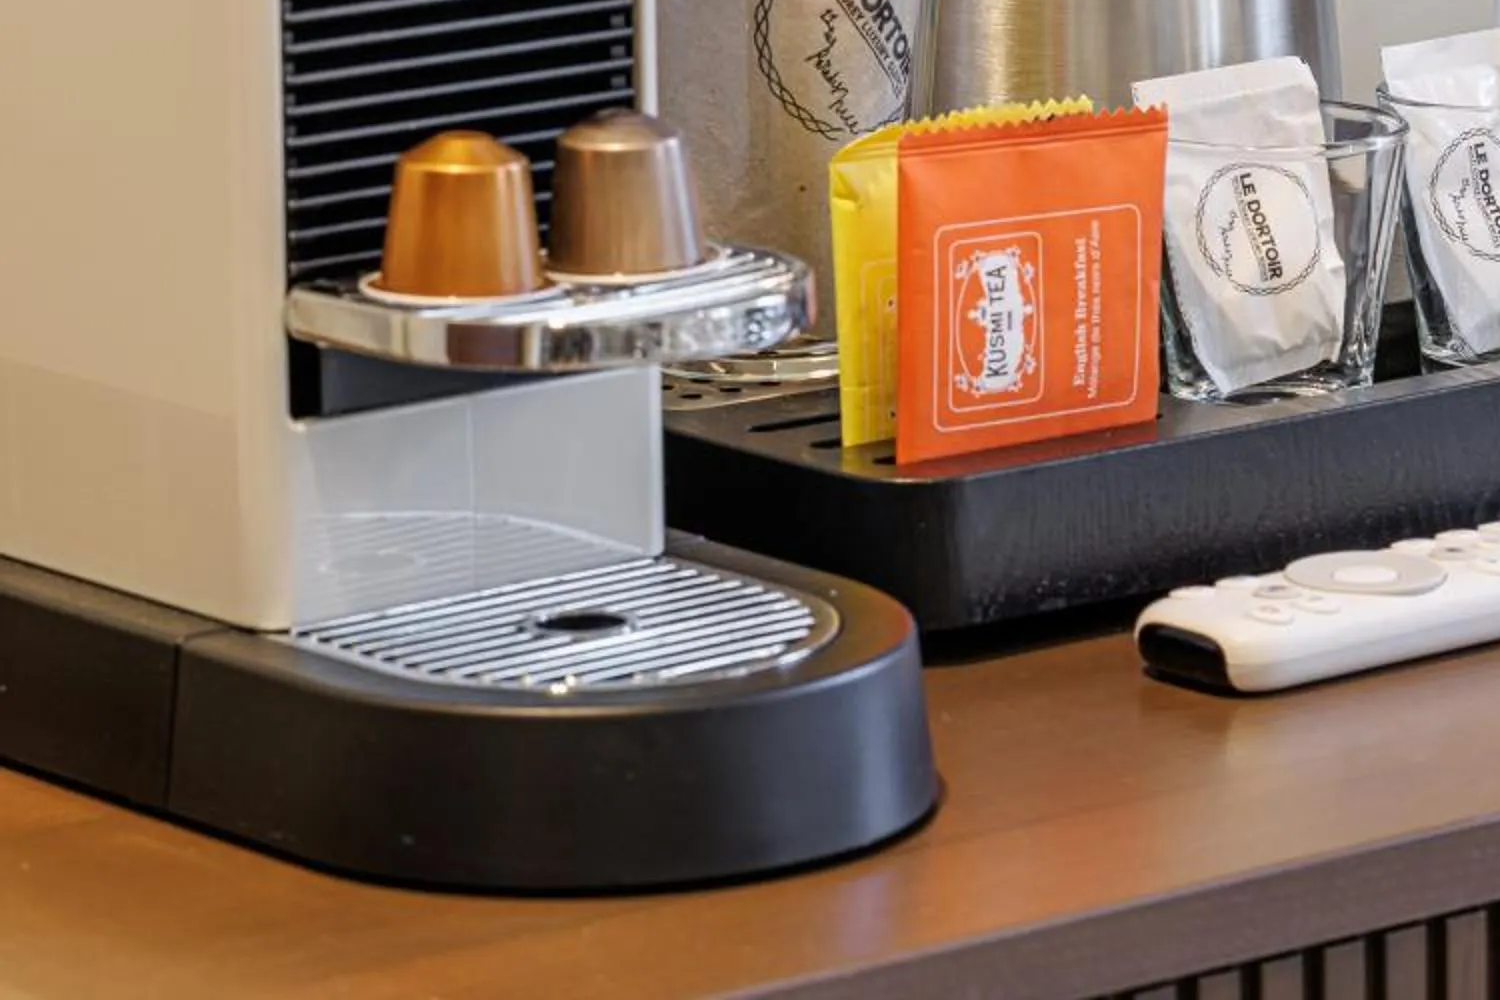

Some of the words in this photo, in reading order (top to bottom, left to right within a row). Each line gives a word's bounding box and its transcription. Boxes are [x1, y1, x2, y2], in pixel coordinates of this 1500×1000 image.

[1474, 142, 1488, 165] LE
[1240, 172, 1256, 197] LE
[1247, 199, 1283, 281] DORTOIR
[985, 264, 1009, 306] TEA
[985, 311, 1009, 379] KUSMI
